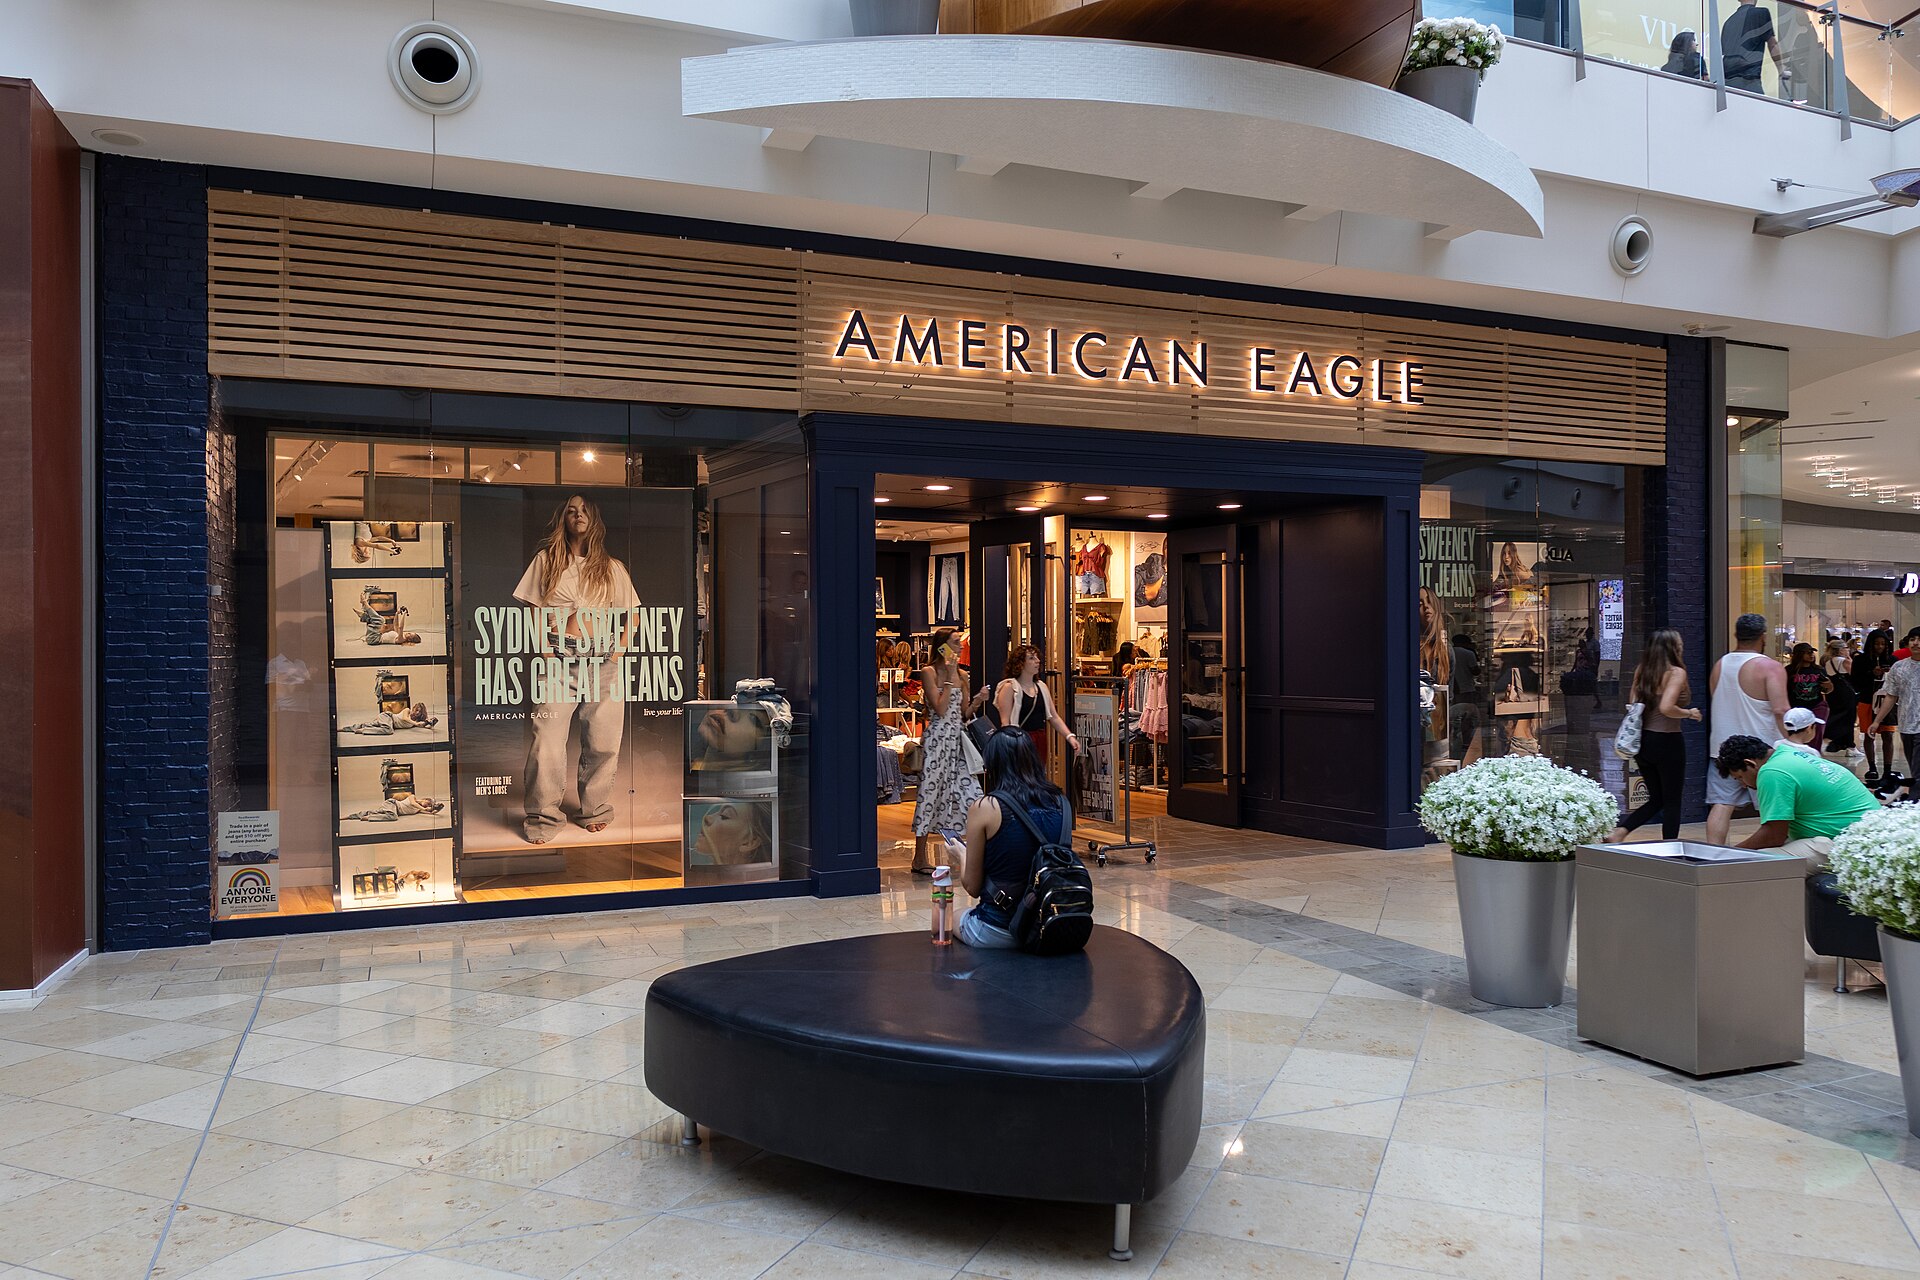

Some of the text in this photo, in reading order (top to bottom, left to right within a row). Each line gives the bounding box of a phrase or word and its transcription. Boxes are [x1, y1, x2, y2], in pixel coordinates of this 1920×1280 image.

[832, 310, 1424, 405] AMERICAN EAGLE
[1419, 526, 1476, 560] SWEENEY
[1435, 563, 1476, 597] JEANS
[1902, 572, 1919, 594] JD
[474, 606, 684, 654] SYDNEY SWEENEY
[475, 655, 684, 705] HAS GREAT JEANS
[531, 711, 559, 719] EAGLE
[643, 708, 656, 716] live
[655, 709, 672, 718] your
[503, 776, 512, 785] THE
[221, 894, 277, 905] EVERYONE
[226, 886, 271, 896] ANYONE
